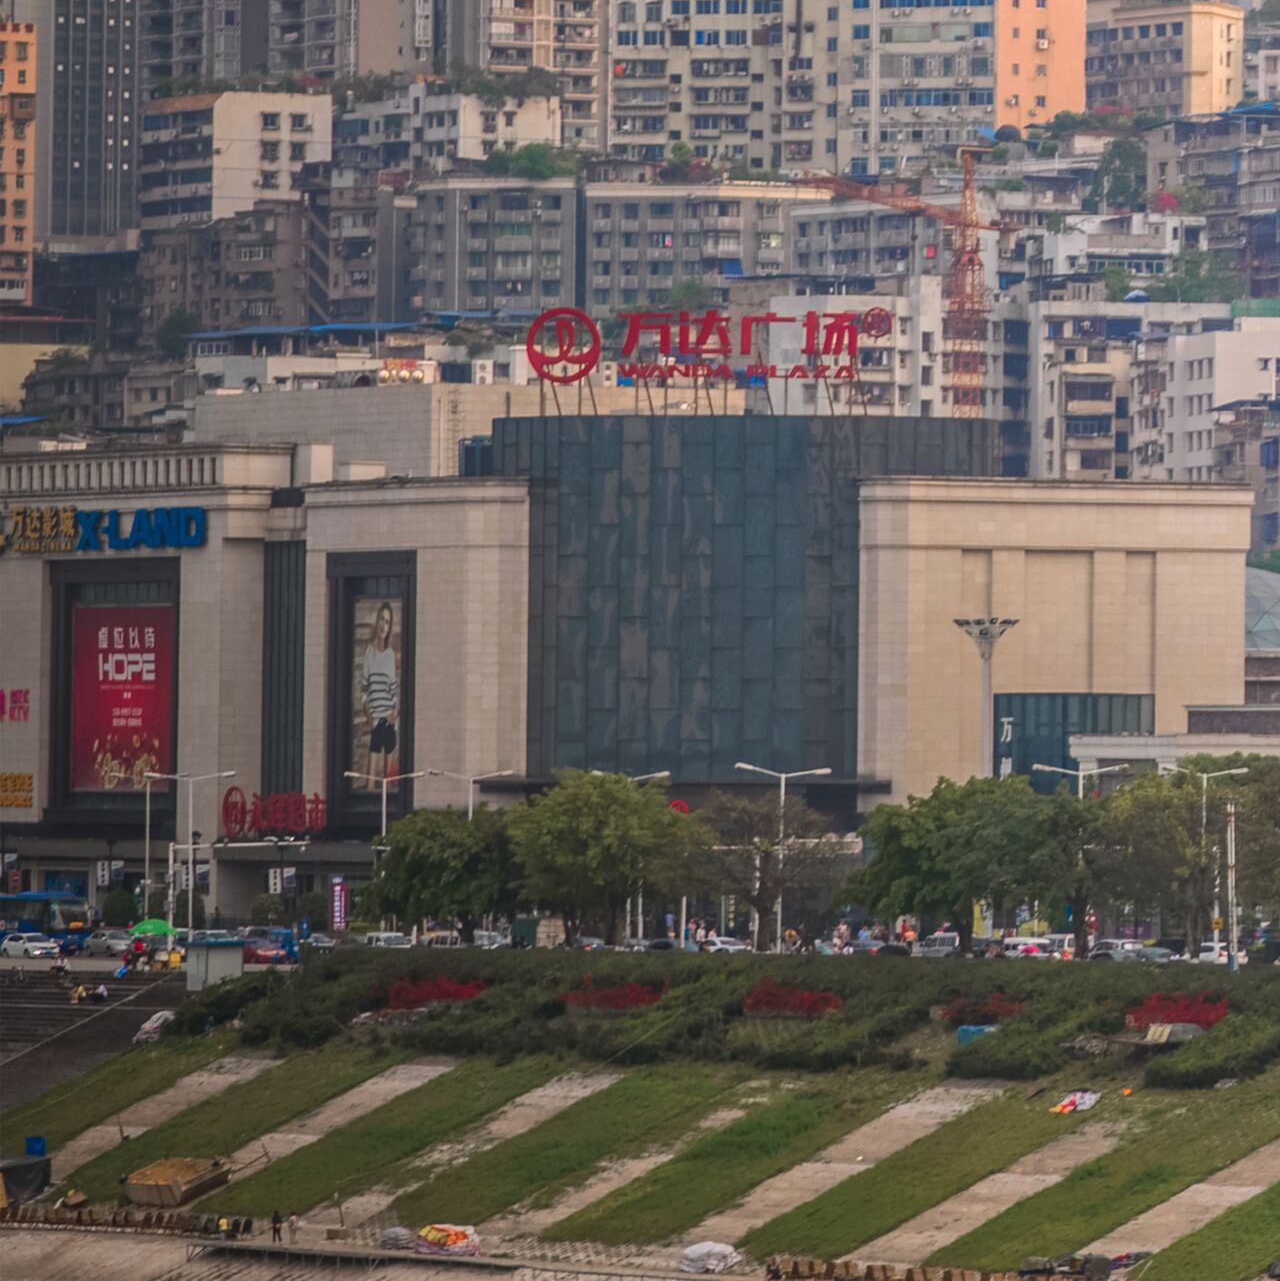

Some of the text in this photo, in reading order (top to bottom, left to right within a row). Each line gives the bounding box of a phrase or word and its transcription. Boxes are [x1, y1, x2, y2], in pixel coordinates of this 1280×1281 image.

[618, 309, 858, 356] 万达广场
[617, 363, 855, 379] WANDA PLAZA
[75, 507, 208, 551] X-LAND
[99, 653, 155, 681] HOPE
